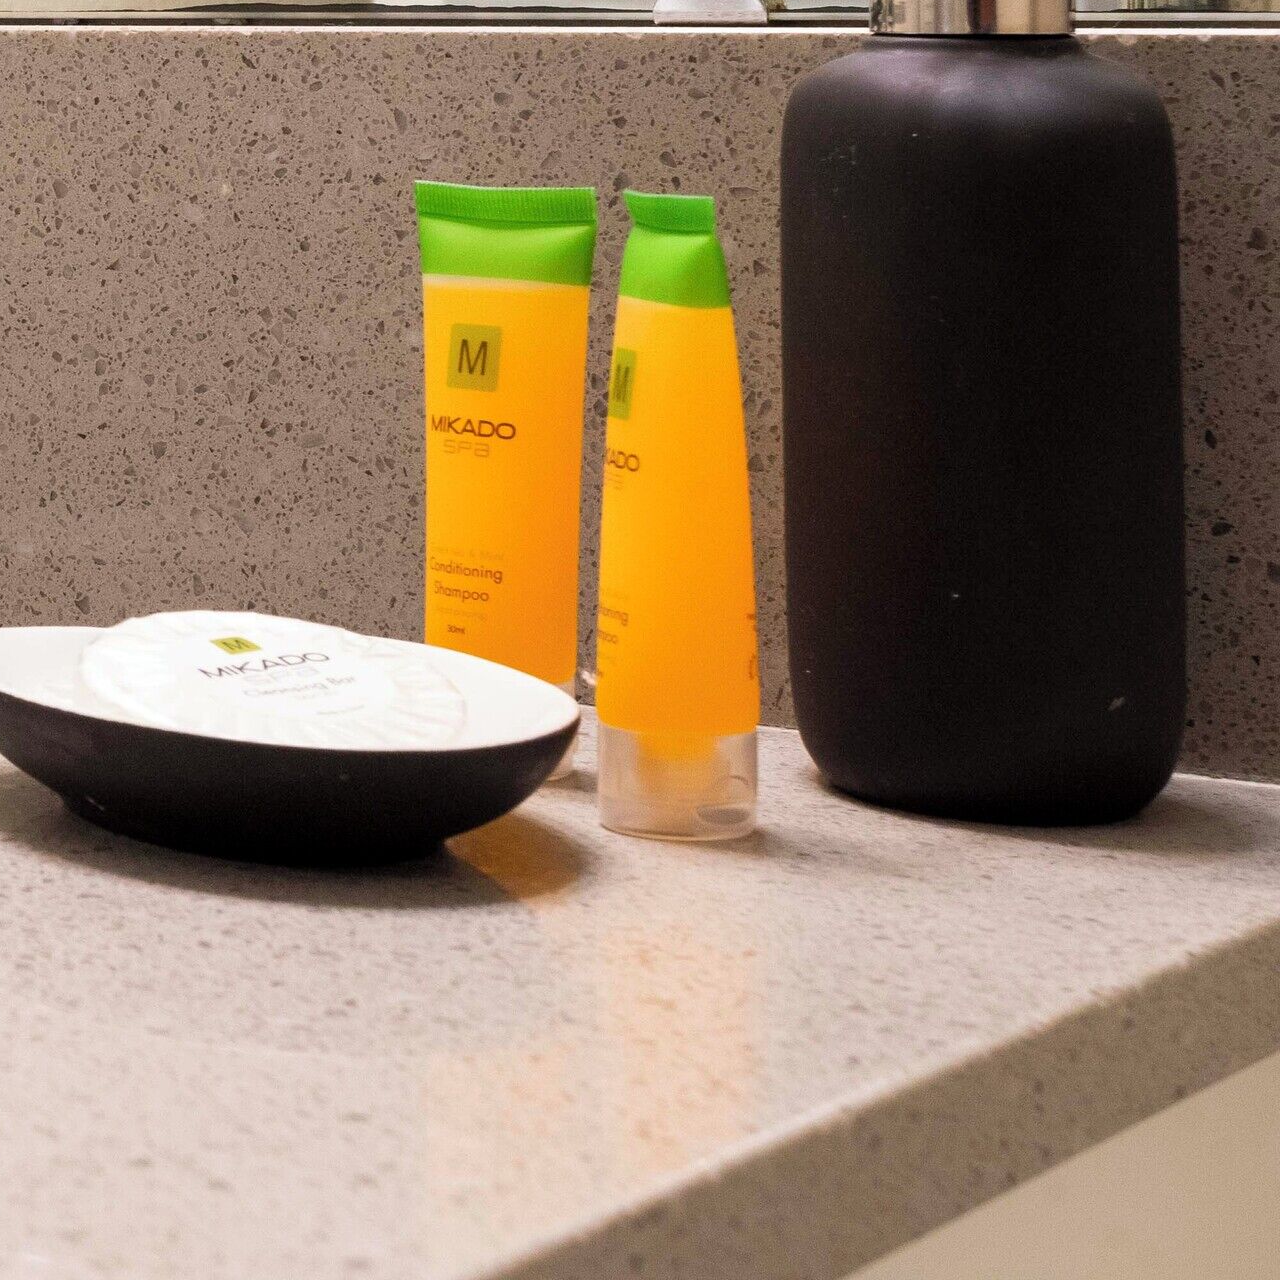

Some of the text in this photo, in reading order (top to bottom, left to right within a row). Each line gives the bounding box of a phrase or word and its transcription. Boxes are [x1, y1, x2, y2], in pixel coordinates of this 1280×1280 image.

[458, 338, 489, 376] M
[430, 413, 517, 440] MIKADO
[430, 556, 504, 585] Conditioning
[433, 580, 490, 603] Shampoo
[221, 638, 251, 652] M
[197, 652, 330, 679] MIKADO
